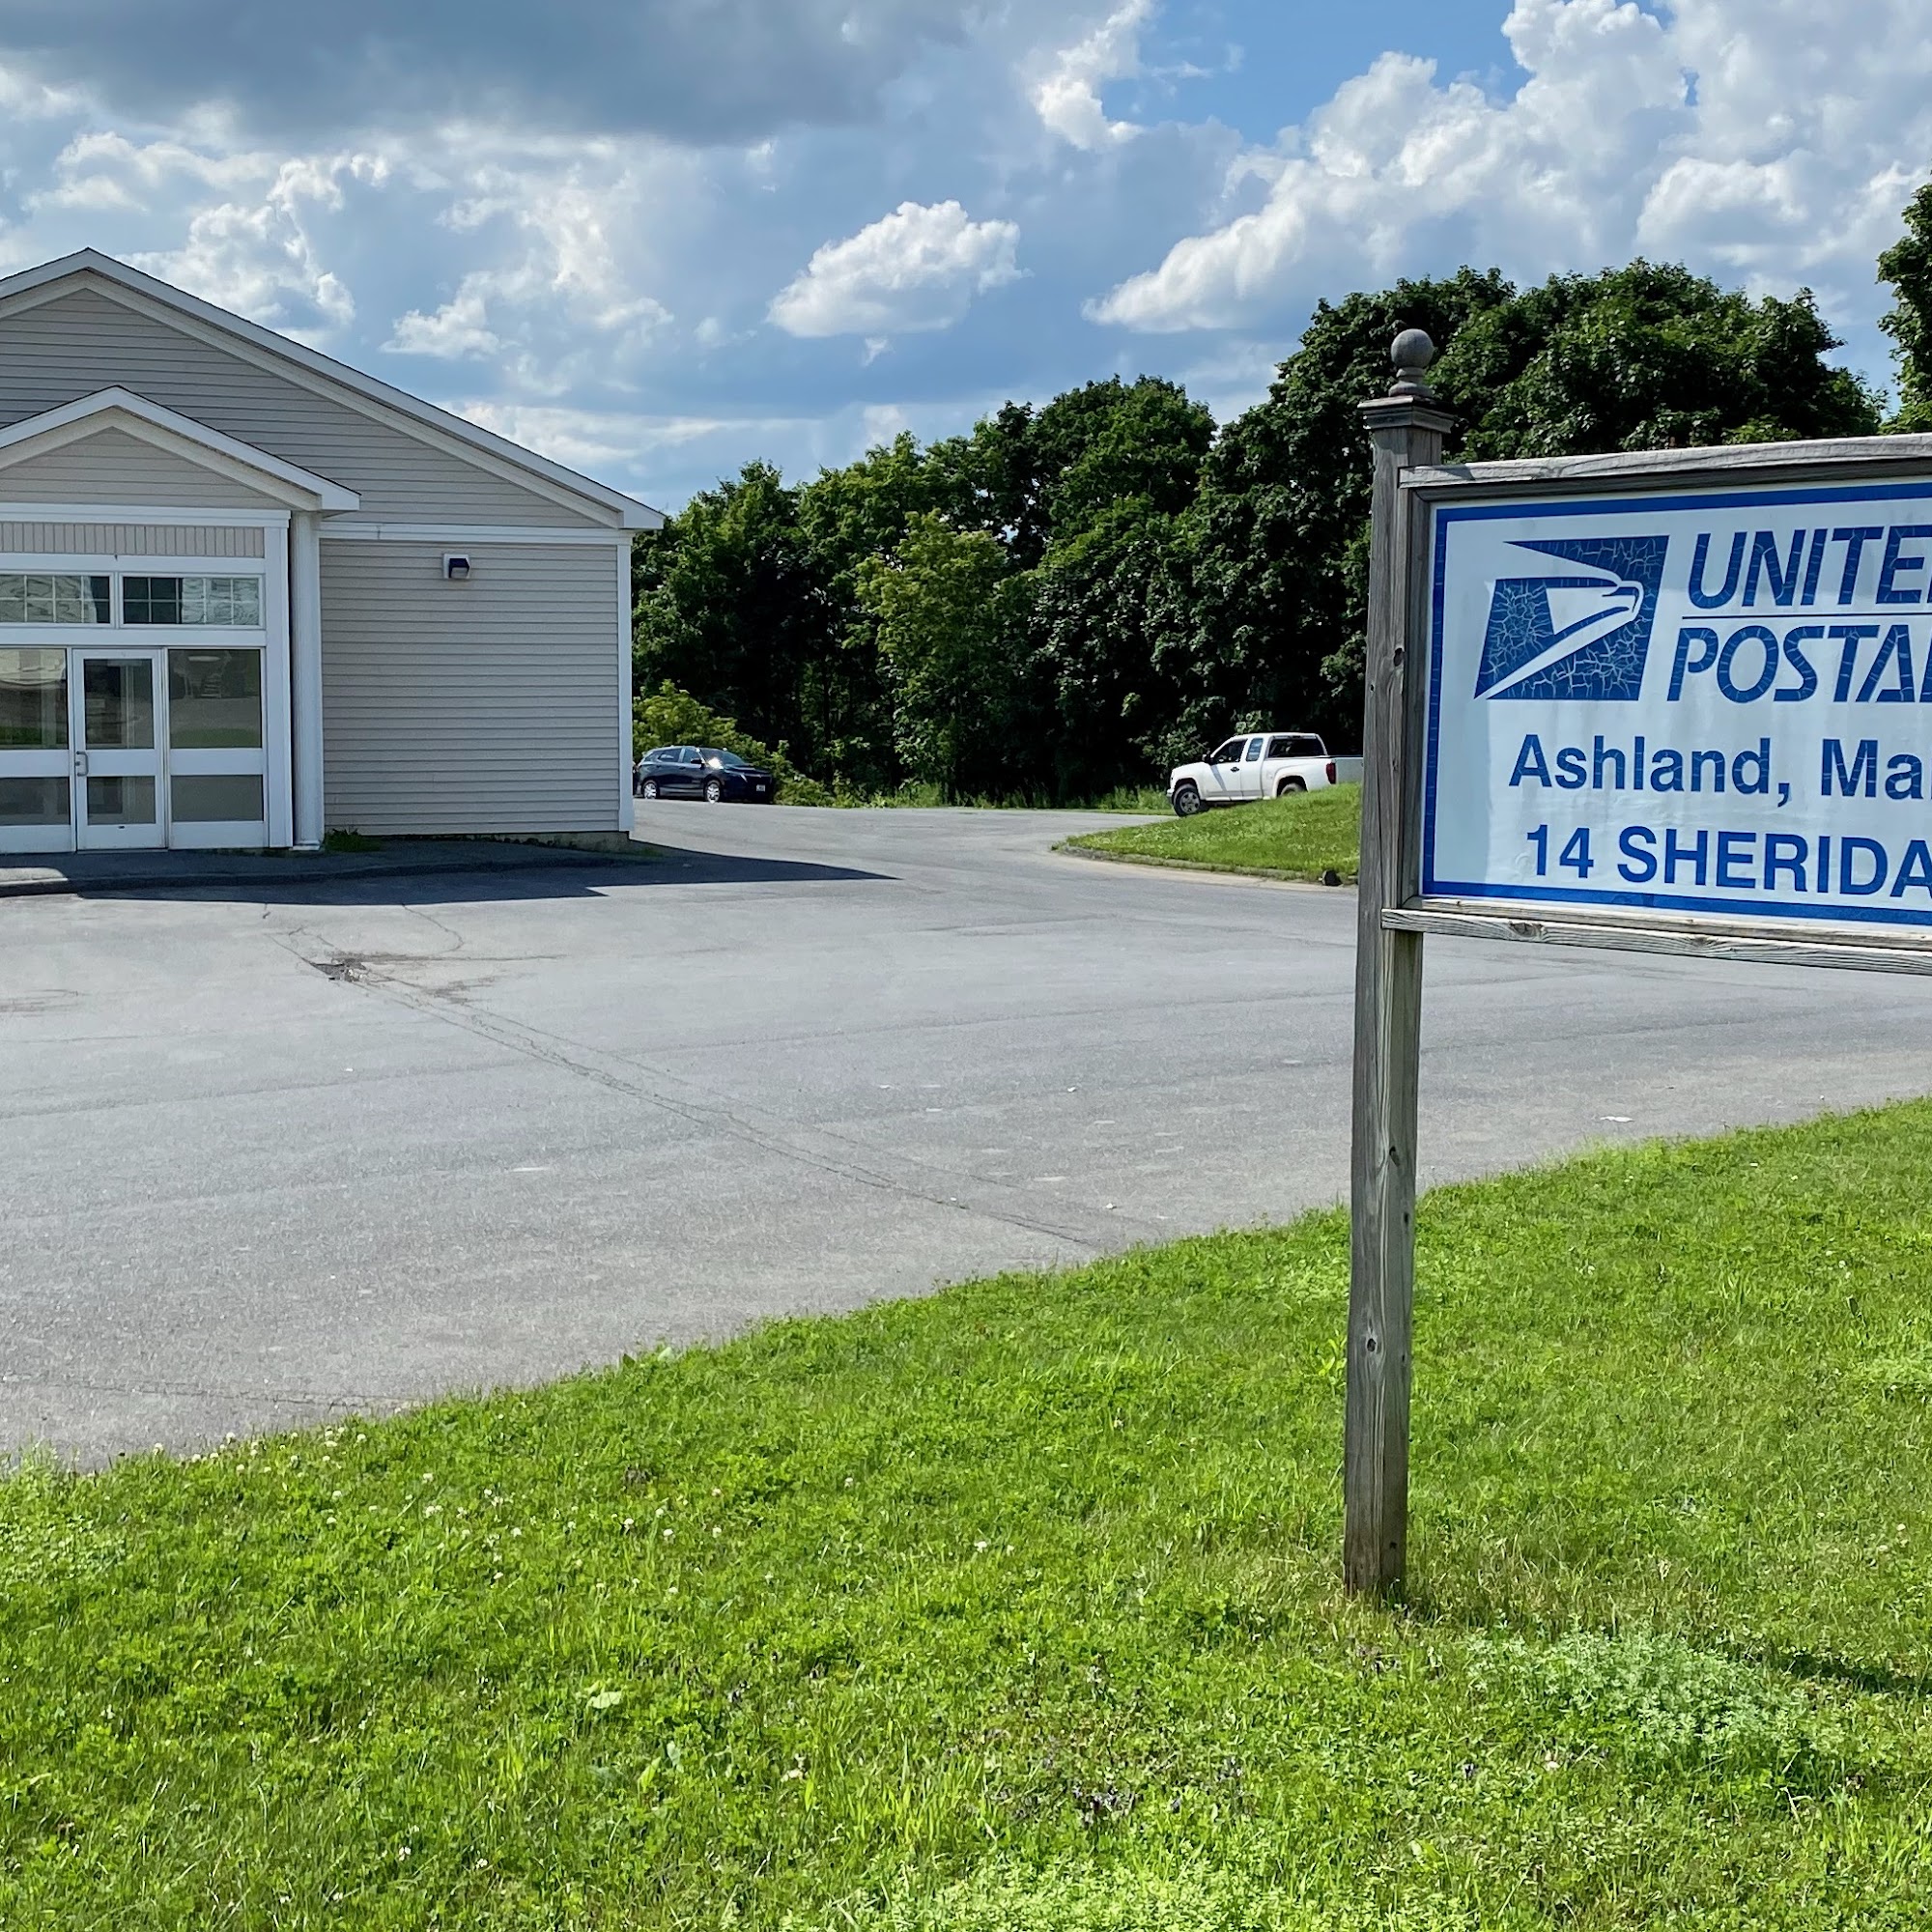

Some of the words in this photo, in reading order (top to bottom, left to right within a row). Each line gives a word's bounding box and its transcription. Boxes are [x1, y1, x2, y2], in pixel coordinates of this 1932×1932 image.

[1689, 525, 1932, 609] UNITE
[1509, 734, 1789, 807] Ashland,
[1822, 739, 1932, 800] Ma
[1527, 825, 1594, 879] 14
[1618, 826, 1932, 898] SHERIDA
